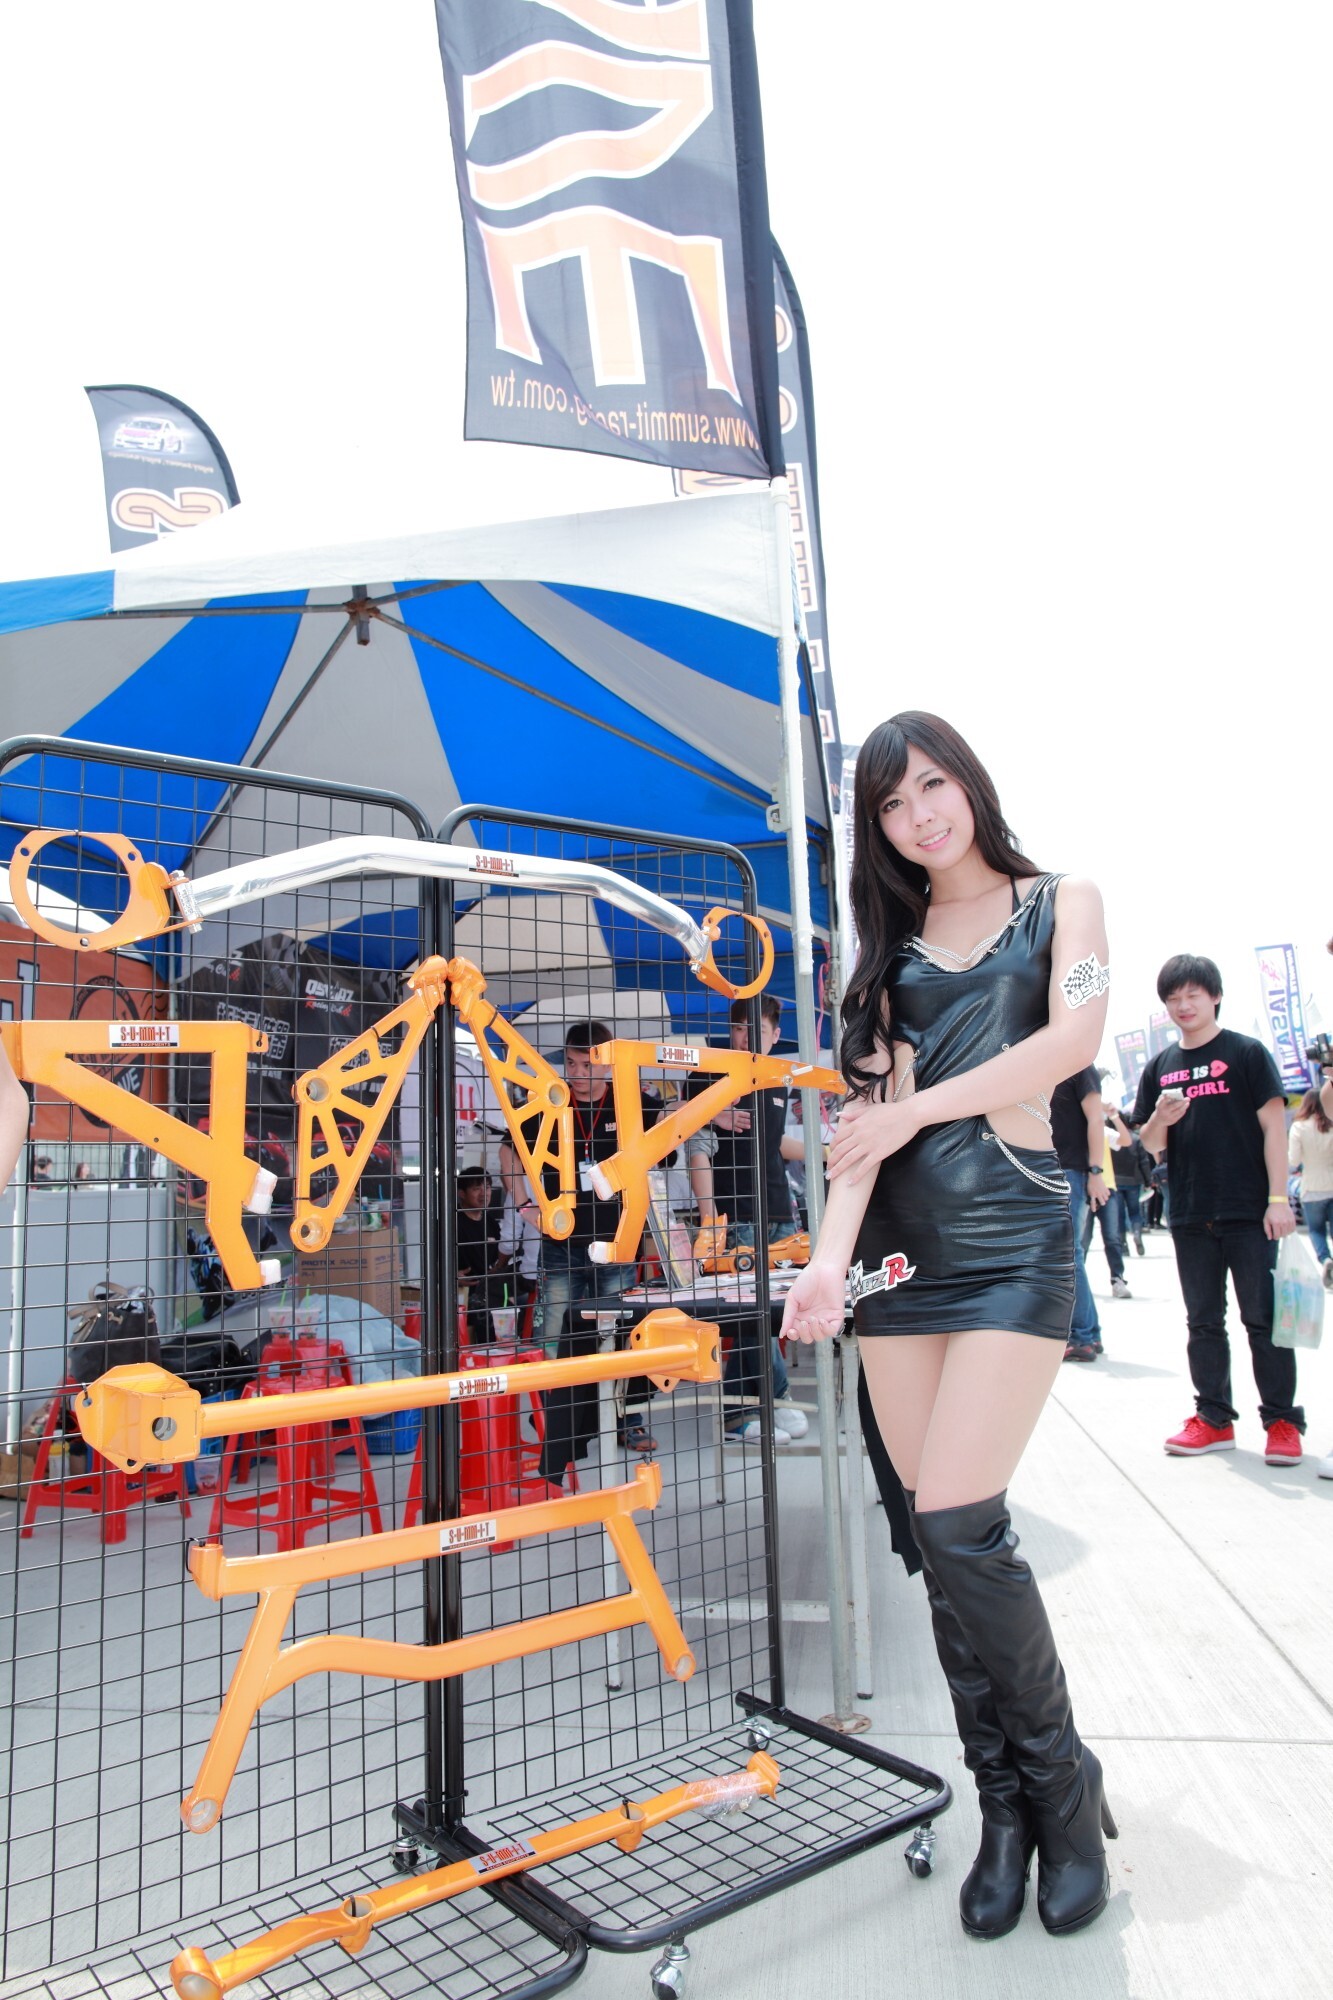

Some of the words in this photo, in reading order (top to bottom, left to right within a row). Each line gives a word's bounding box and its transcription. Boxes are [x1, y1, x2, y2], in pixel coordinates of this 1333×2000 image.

[1160, 1069, 1190, 1087] SHE
[1193, 1065, 1209, 1079] IS
[1186, 1080, 1230, 1098] GIRL
